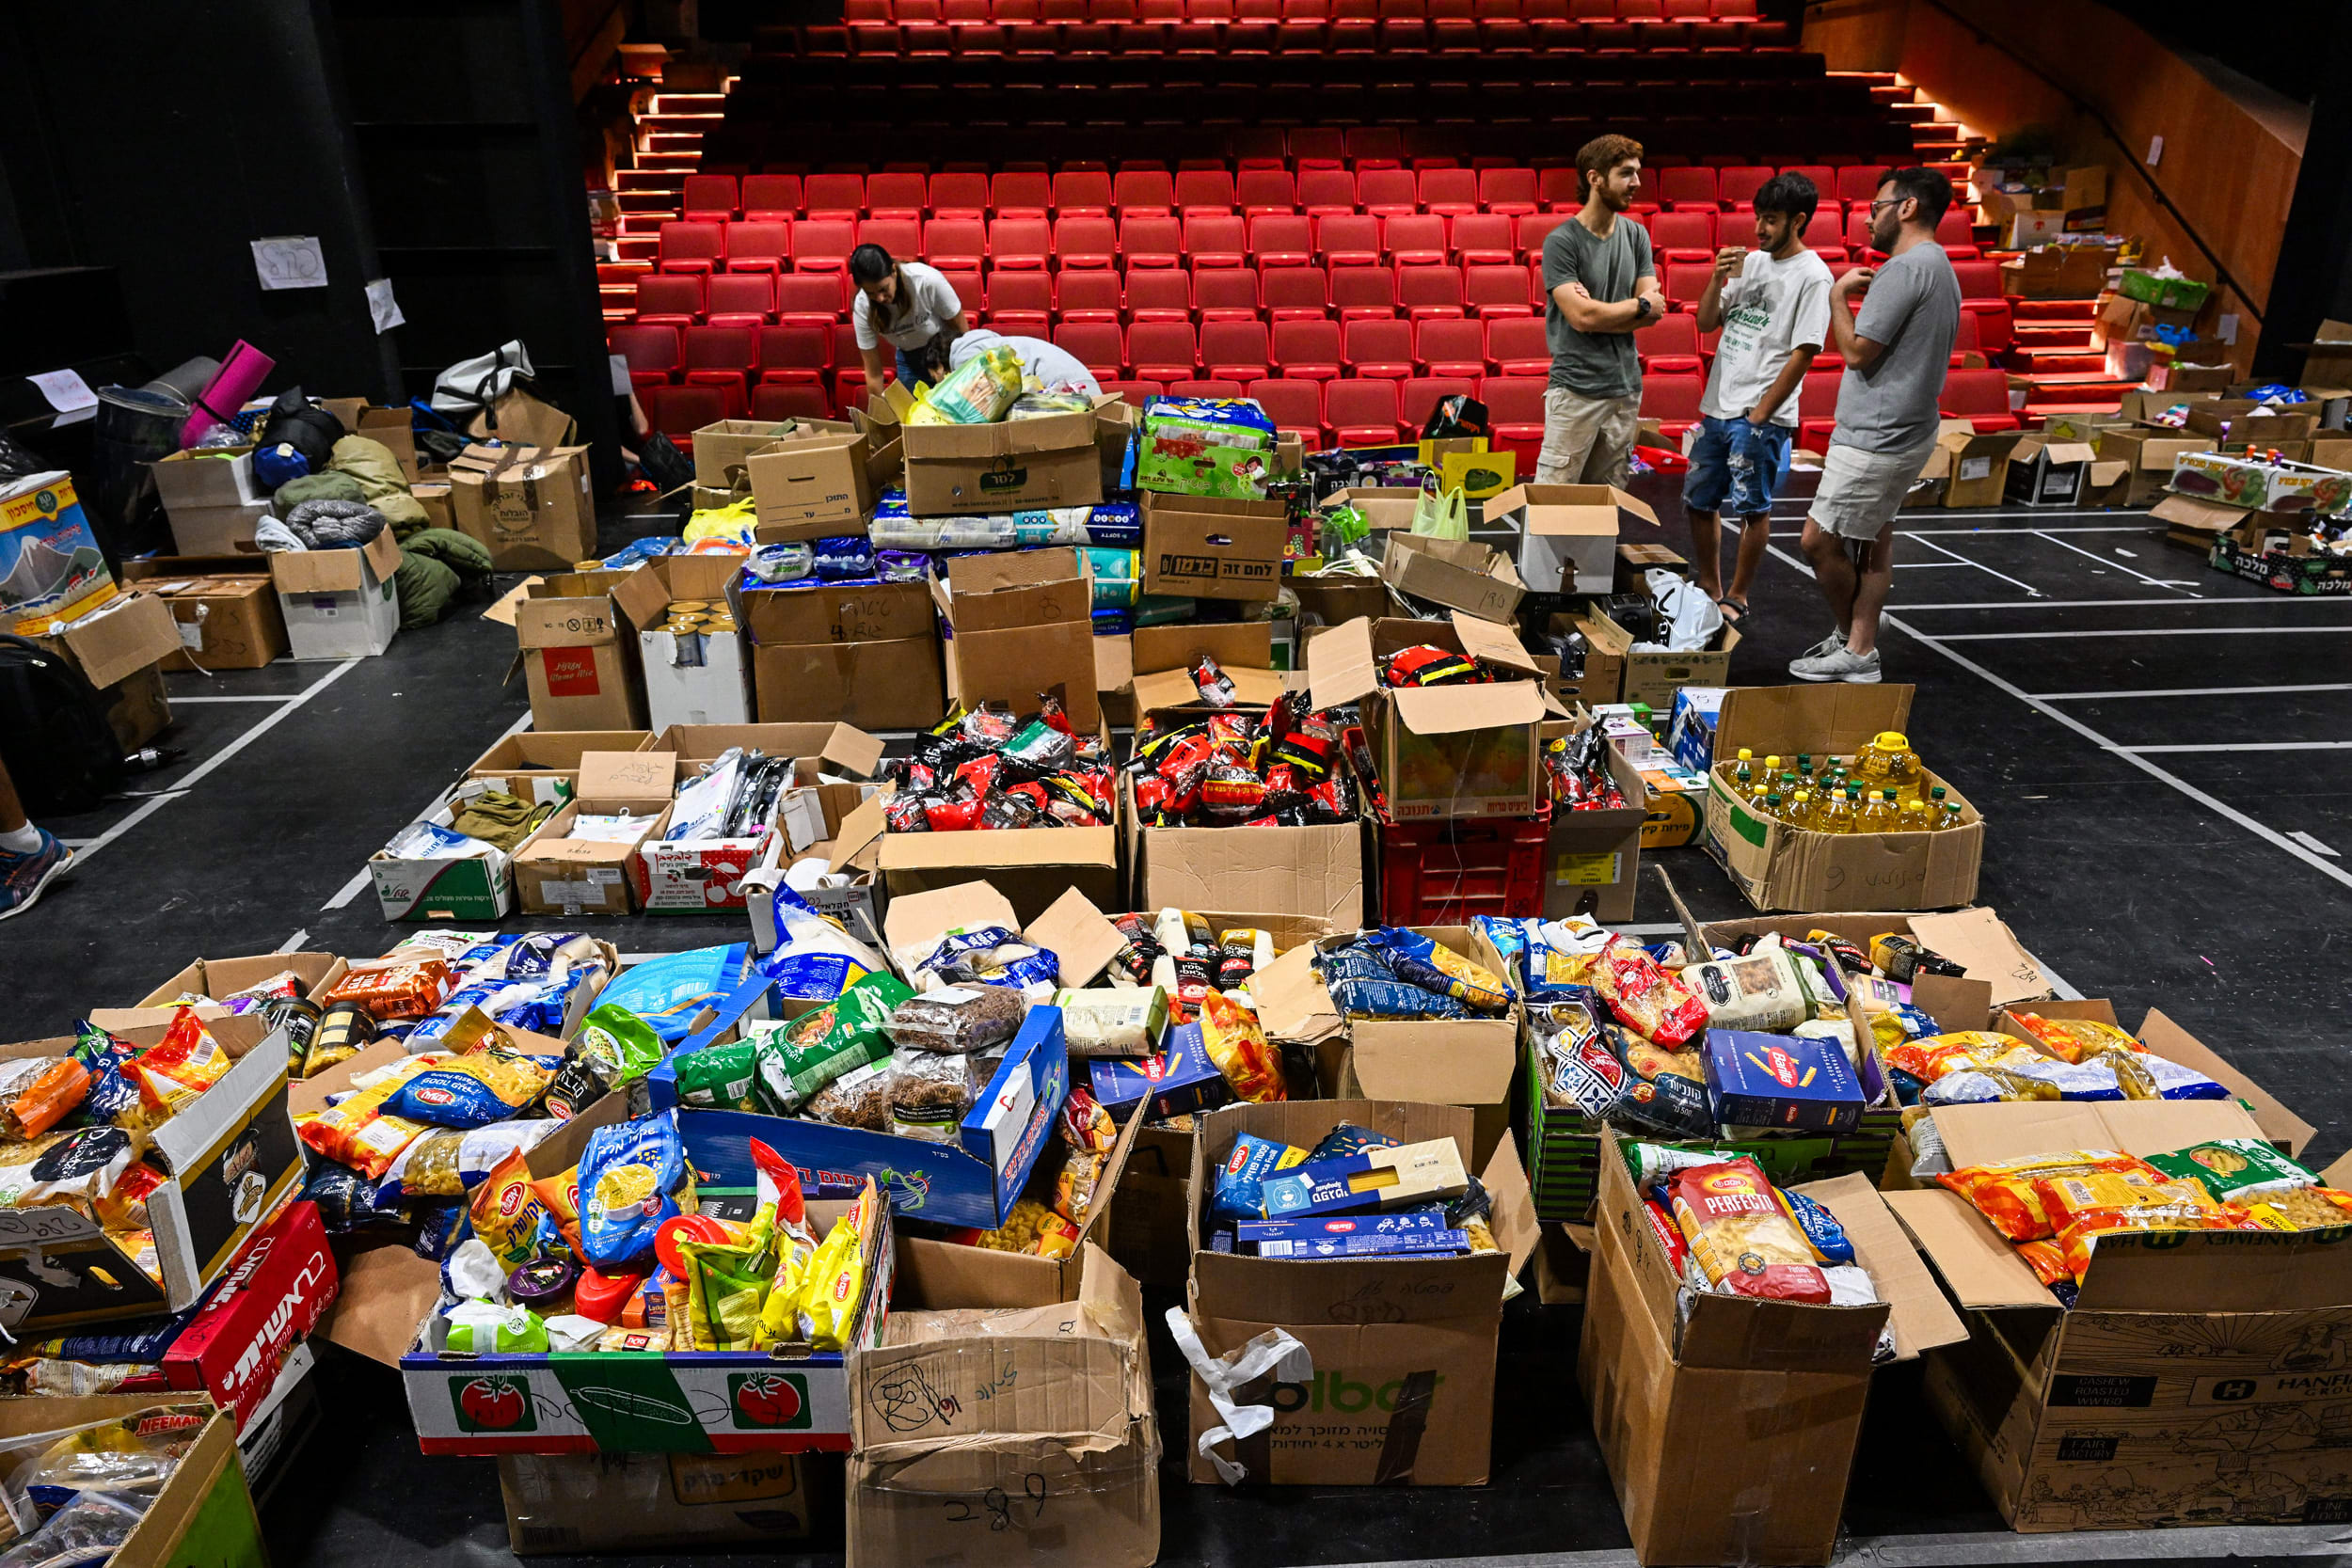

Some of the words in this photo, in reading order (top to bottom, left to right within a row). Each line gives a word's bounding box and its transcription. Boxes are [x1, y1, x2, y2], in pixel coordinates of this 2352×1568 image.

[825, 493, 849, 504] התוכן
[1223, 564, 1240, 574] זה
[1244, 563, 1273, 576] לחם
[2235, 556, 2268, 575] מלכה
[2317, 579, 2352, 591] מלכה
[1661, 822, 1691, 832] פירות
[1772, 1051, 1794, 1086] Barilla
[1231, 1148, 1247, 1169] טעמן
[1255, 1143, 1270, 1164] פסטה
[1311, 1188, 1349, 1204] ספגטי
[1704, 1194, 1776, 1214] PERFECTO
[233, 1250, 326, 1387] בראשית
[2078, 1377, 2131, 1386] CASHEW
[2074, 1386, 2130, 1396] ROASTED
[140, 1415, 204, 1433] NEEMAN
[1270, 1424, 1302, 1435] למא
[1308, 1425, 1348, 1437] מזוכך
[1271, 1438, 1318, 1450] יחידות
[1322, 1439, 1335, 1449] 4
[2071, 1440, 2106, 1449] FAIR
[2061, 1449, 2113, 1459] FACTORY
[728, 1464, 784, 1487] שקדי
